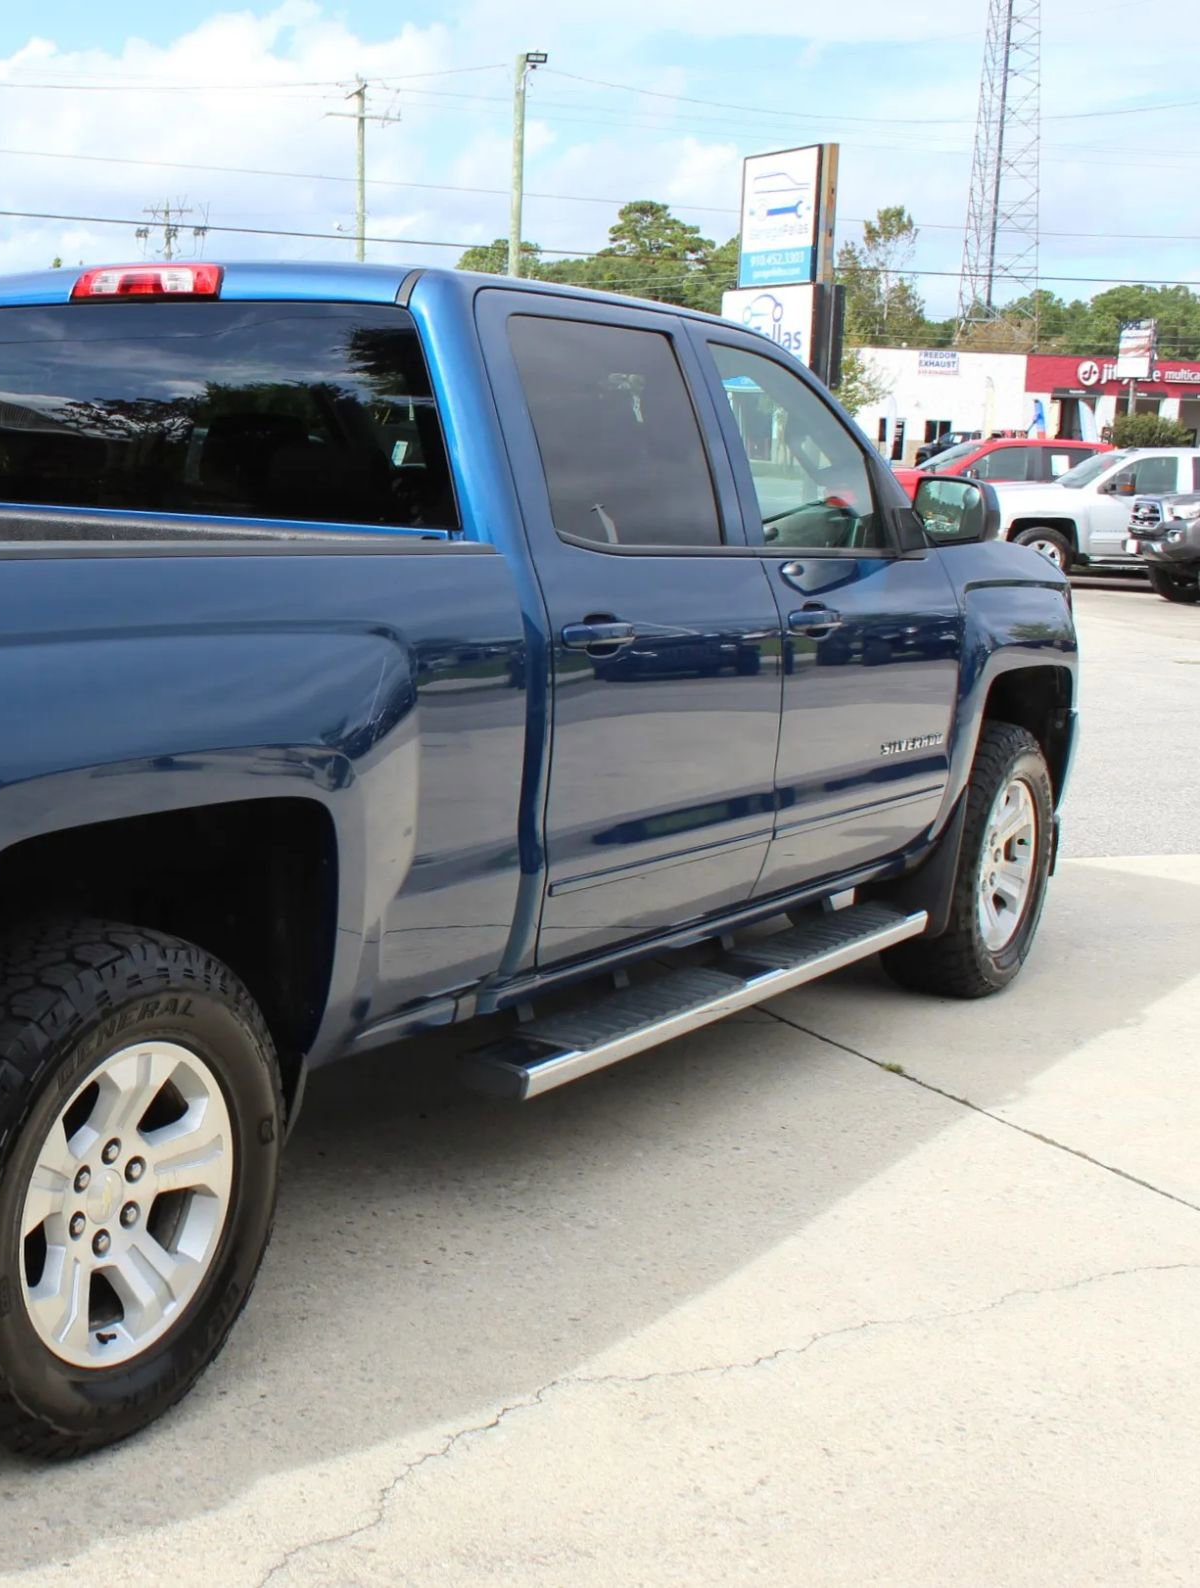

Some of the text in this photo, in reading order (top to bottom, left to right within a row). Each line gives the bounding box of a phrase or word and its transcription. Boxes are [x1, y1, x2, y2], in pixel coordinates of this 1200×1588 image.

[919, 351, 957, 359] FREEDOM
[918, 360, 957, 368] EXHAUST
[881, 734, 944, 755] SILVERADO
